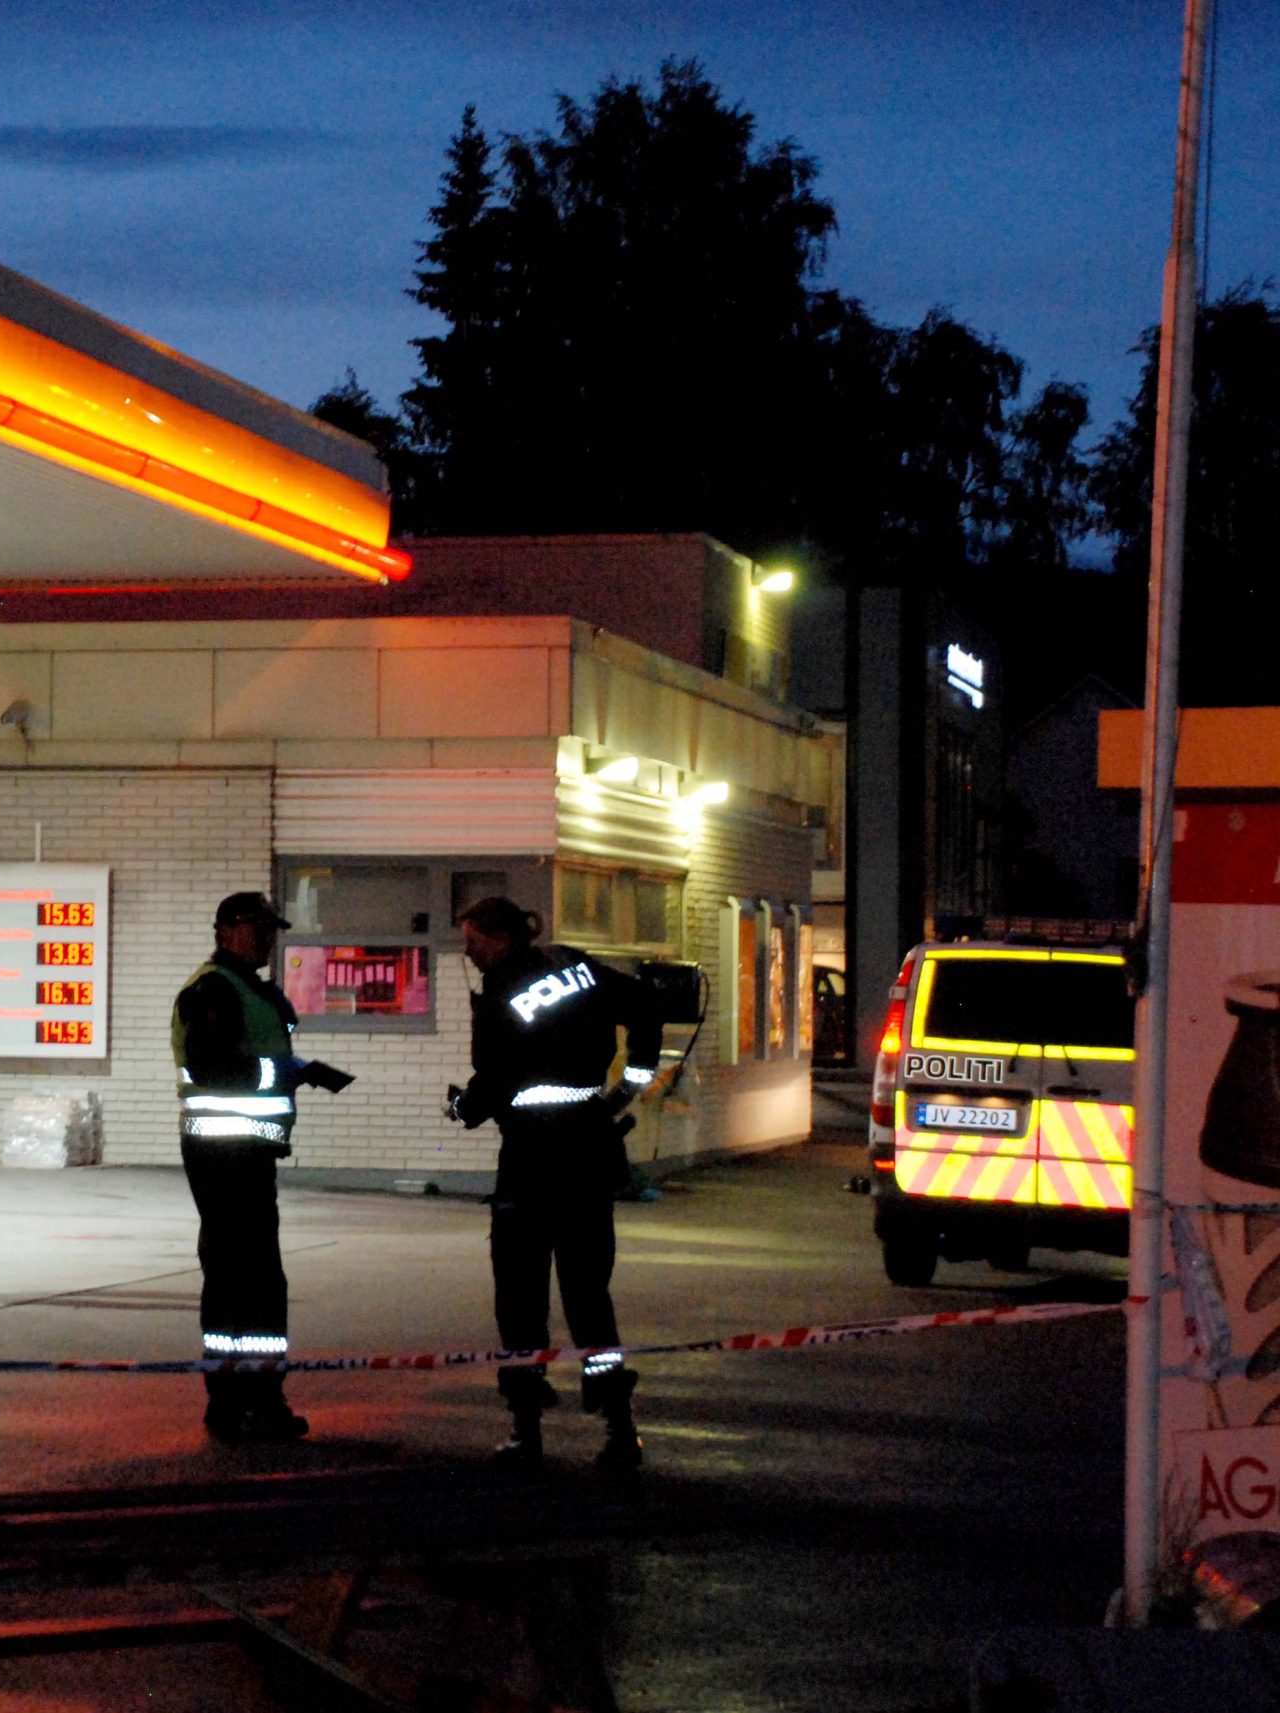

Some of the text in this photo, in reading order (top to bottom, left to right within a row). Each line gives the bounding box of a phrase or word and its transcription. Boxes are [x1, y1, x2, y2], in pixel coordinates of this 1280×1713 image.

[904, 1053, 1003, 1083] POLITI
[931, 1107, 951, 1122] JV
[958, 1109, 1010, 1126] 22202
[1199, 1452, 1280, 1519] AG
